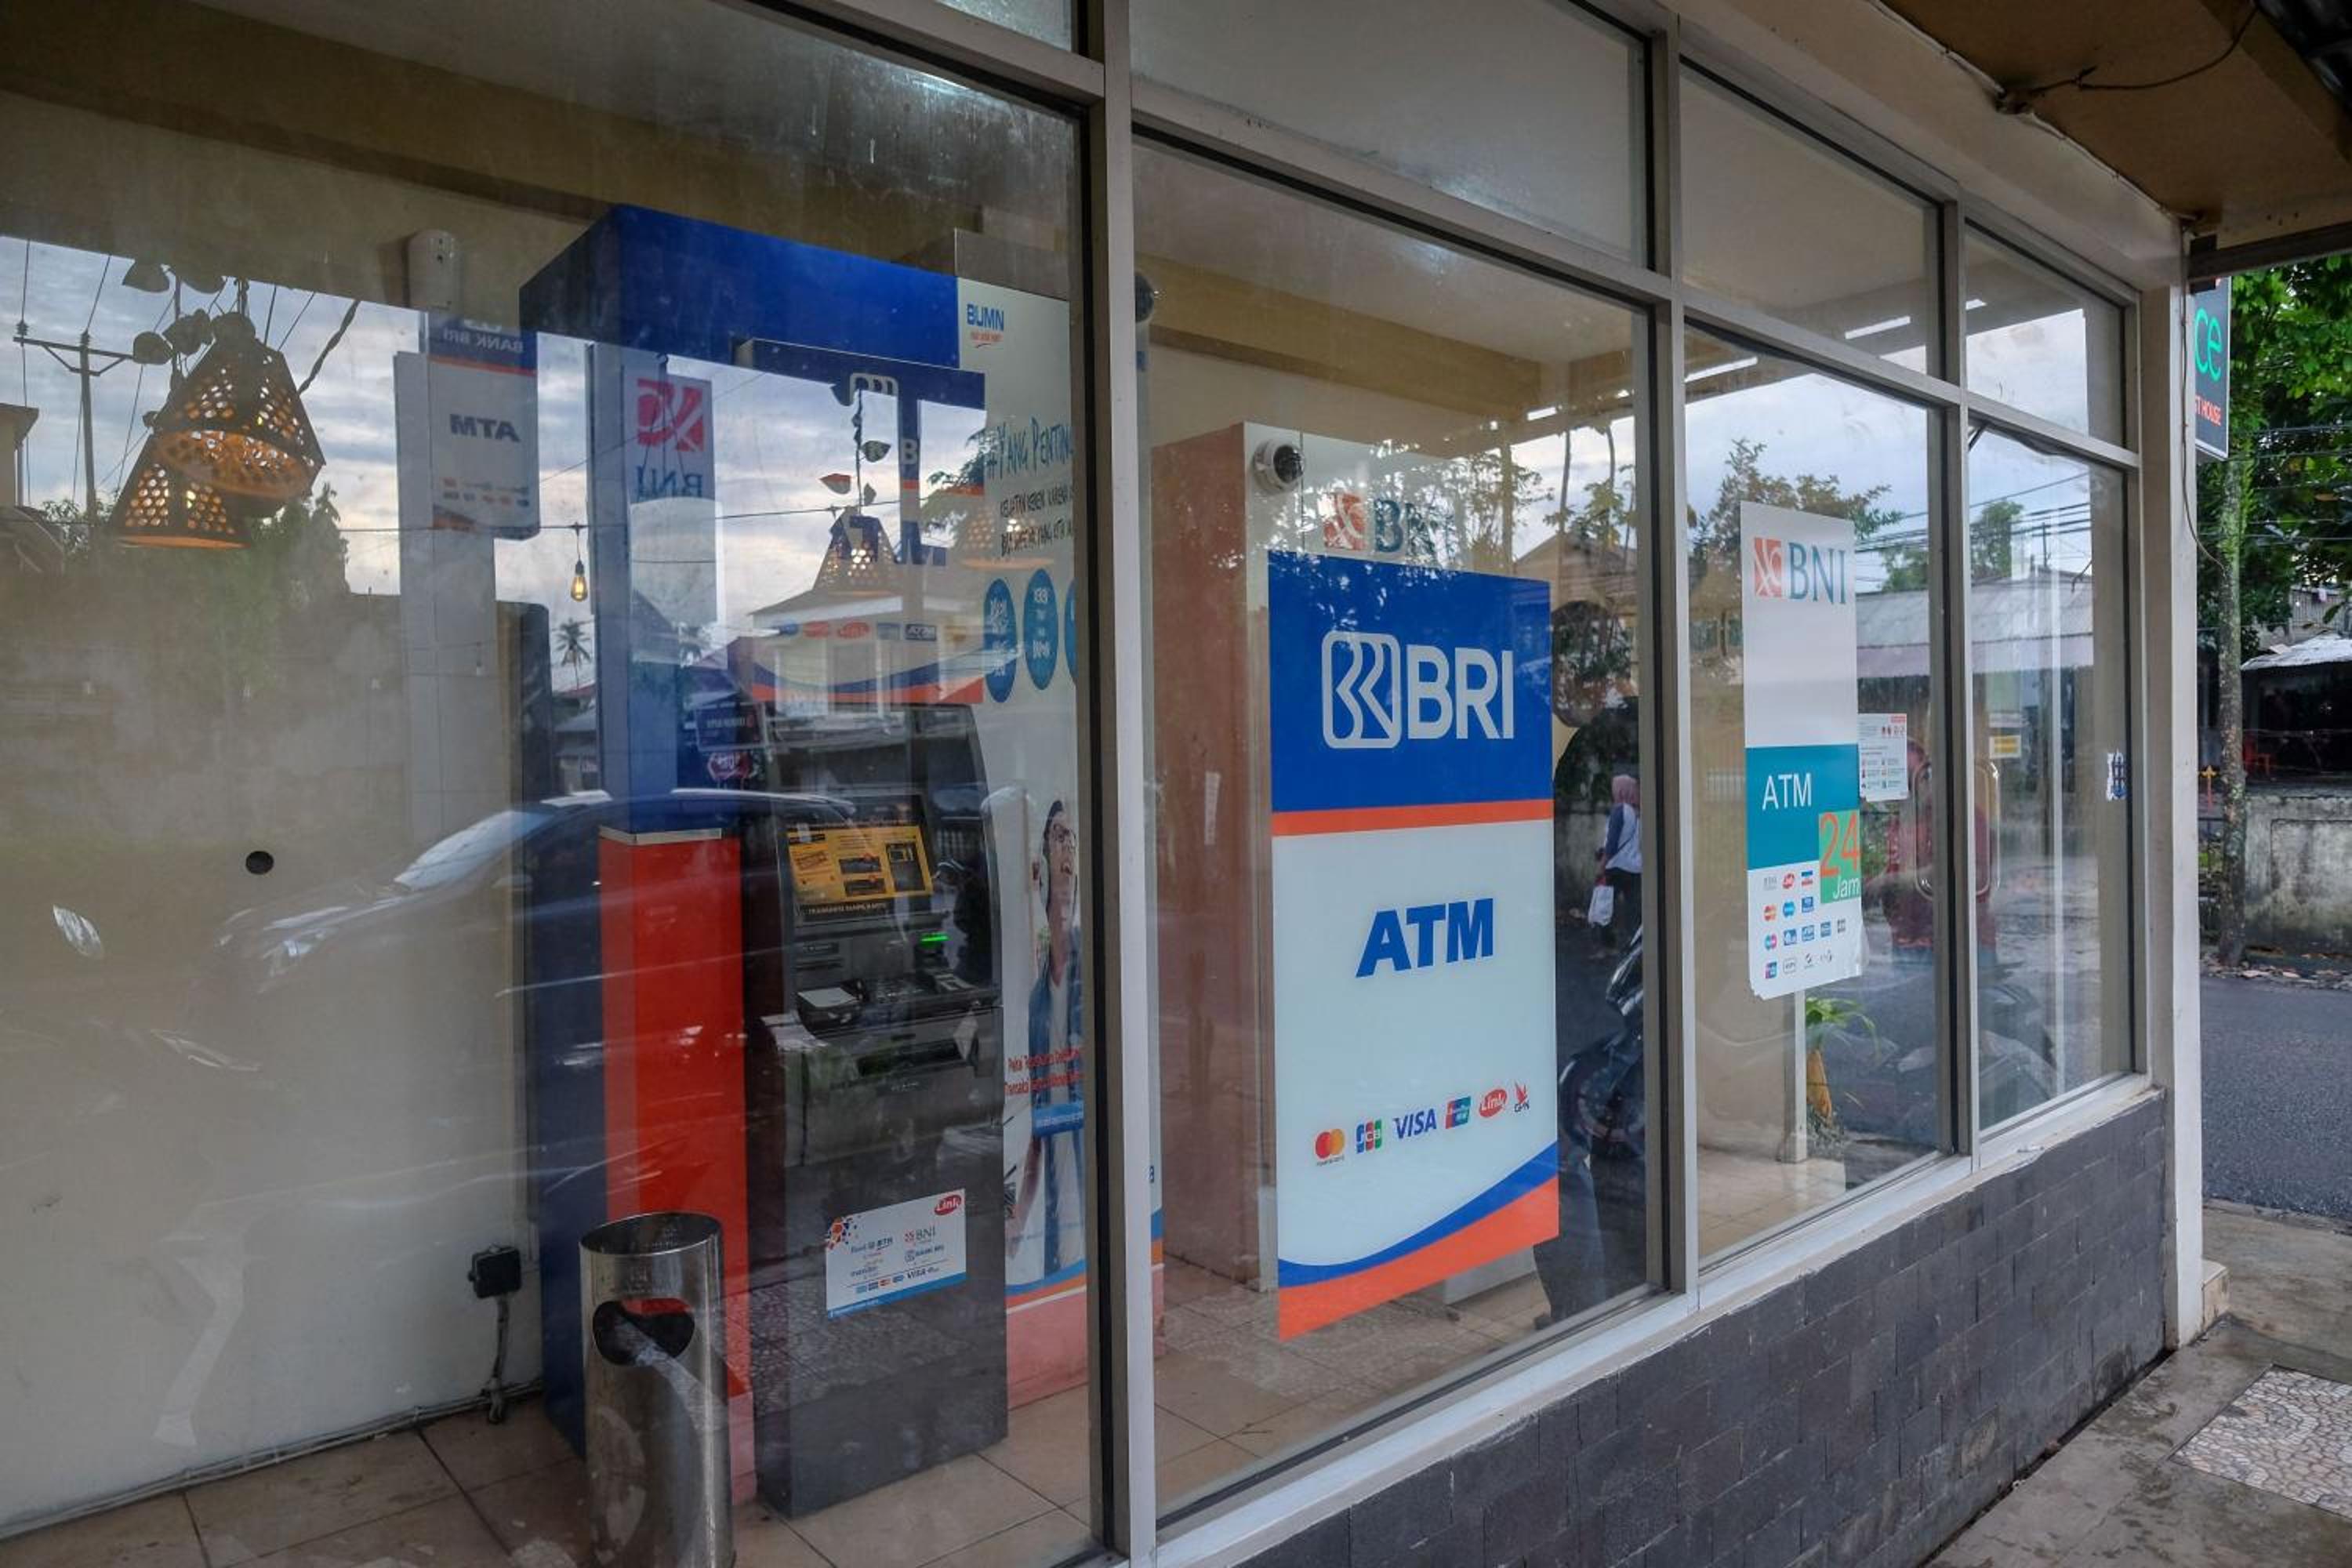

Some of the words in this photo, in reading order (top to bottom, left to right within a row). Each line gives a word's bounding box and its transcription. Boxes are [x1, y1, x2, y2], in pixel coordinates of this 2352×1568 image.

[966, 303, 1004, 331] BUMN
[2195, 307, 2222, 382] ce
[1788, 541, 1847, 605] BNI
[1406, 644, 1515, 740] BRI
[1762, 772, 1813, 811] ATM
[1820, 811, 1860, 877] 24
[1832, 876, 1860, 899] Jam
[1355, 898, 1494, 978] ATM
[1392, 1108, 1437, 1140] VISA
[916, 1226, 936, 1241] BNI
